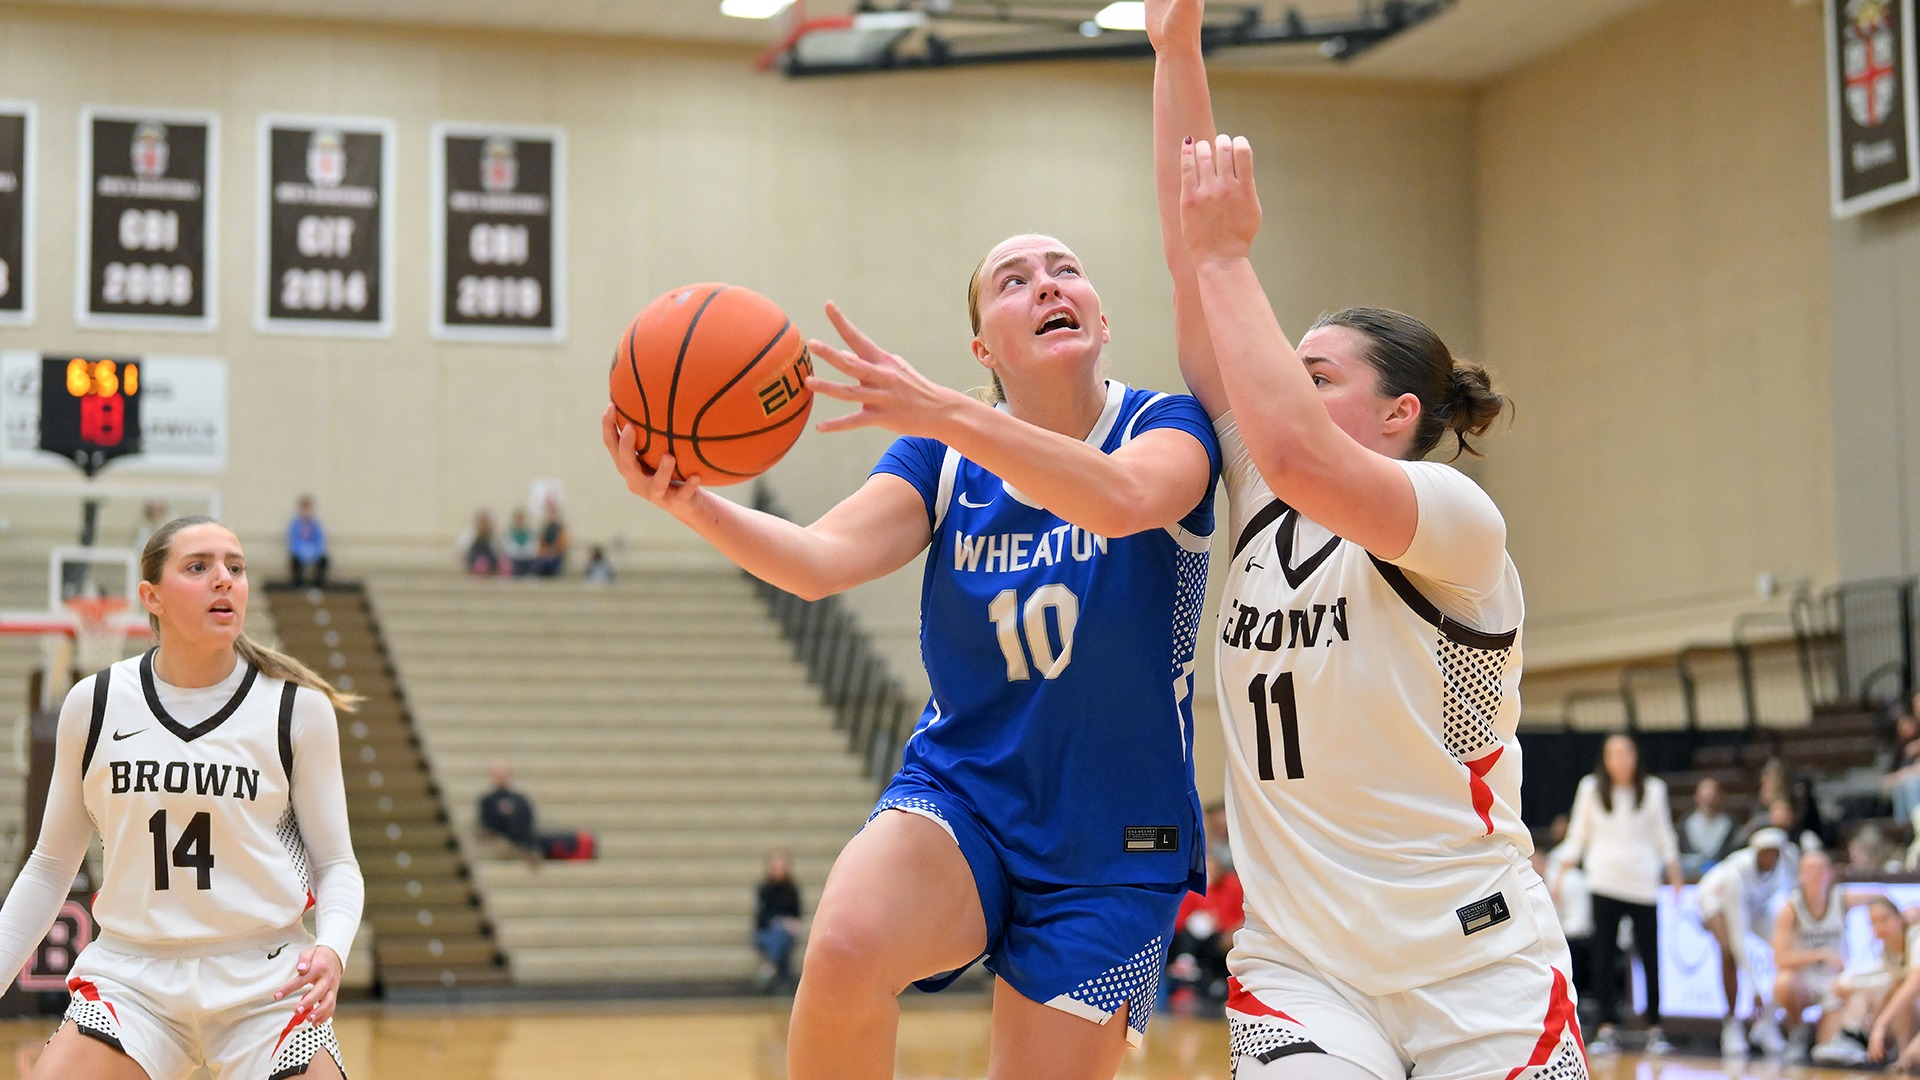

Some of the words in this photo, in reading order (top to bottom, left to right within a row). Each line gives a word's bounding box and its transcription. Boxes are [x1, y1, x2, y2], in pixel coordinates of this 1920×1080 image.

[118, 208, 178, 251] CBI
[298, 215, 355, 258] CIT
[469, 223, 528, 266] CBI
[282, 268, 367, 312] 2014
[954, 523, 1108, 573] WHEATON
[988, 583, 1080, 682] 10
[1248, 671, 1305, 781] 11
[110, 760, 260, 801] BROWN
[148, 809, 215, 891] 14
[1163, 833, 1169, 844] L
